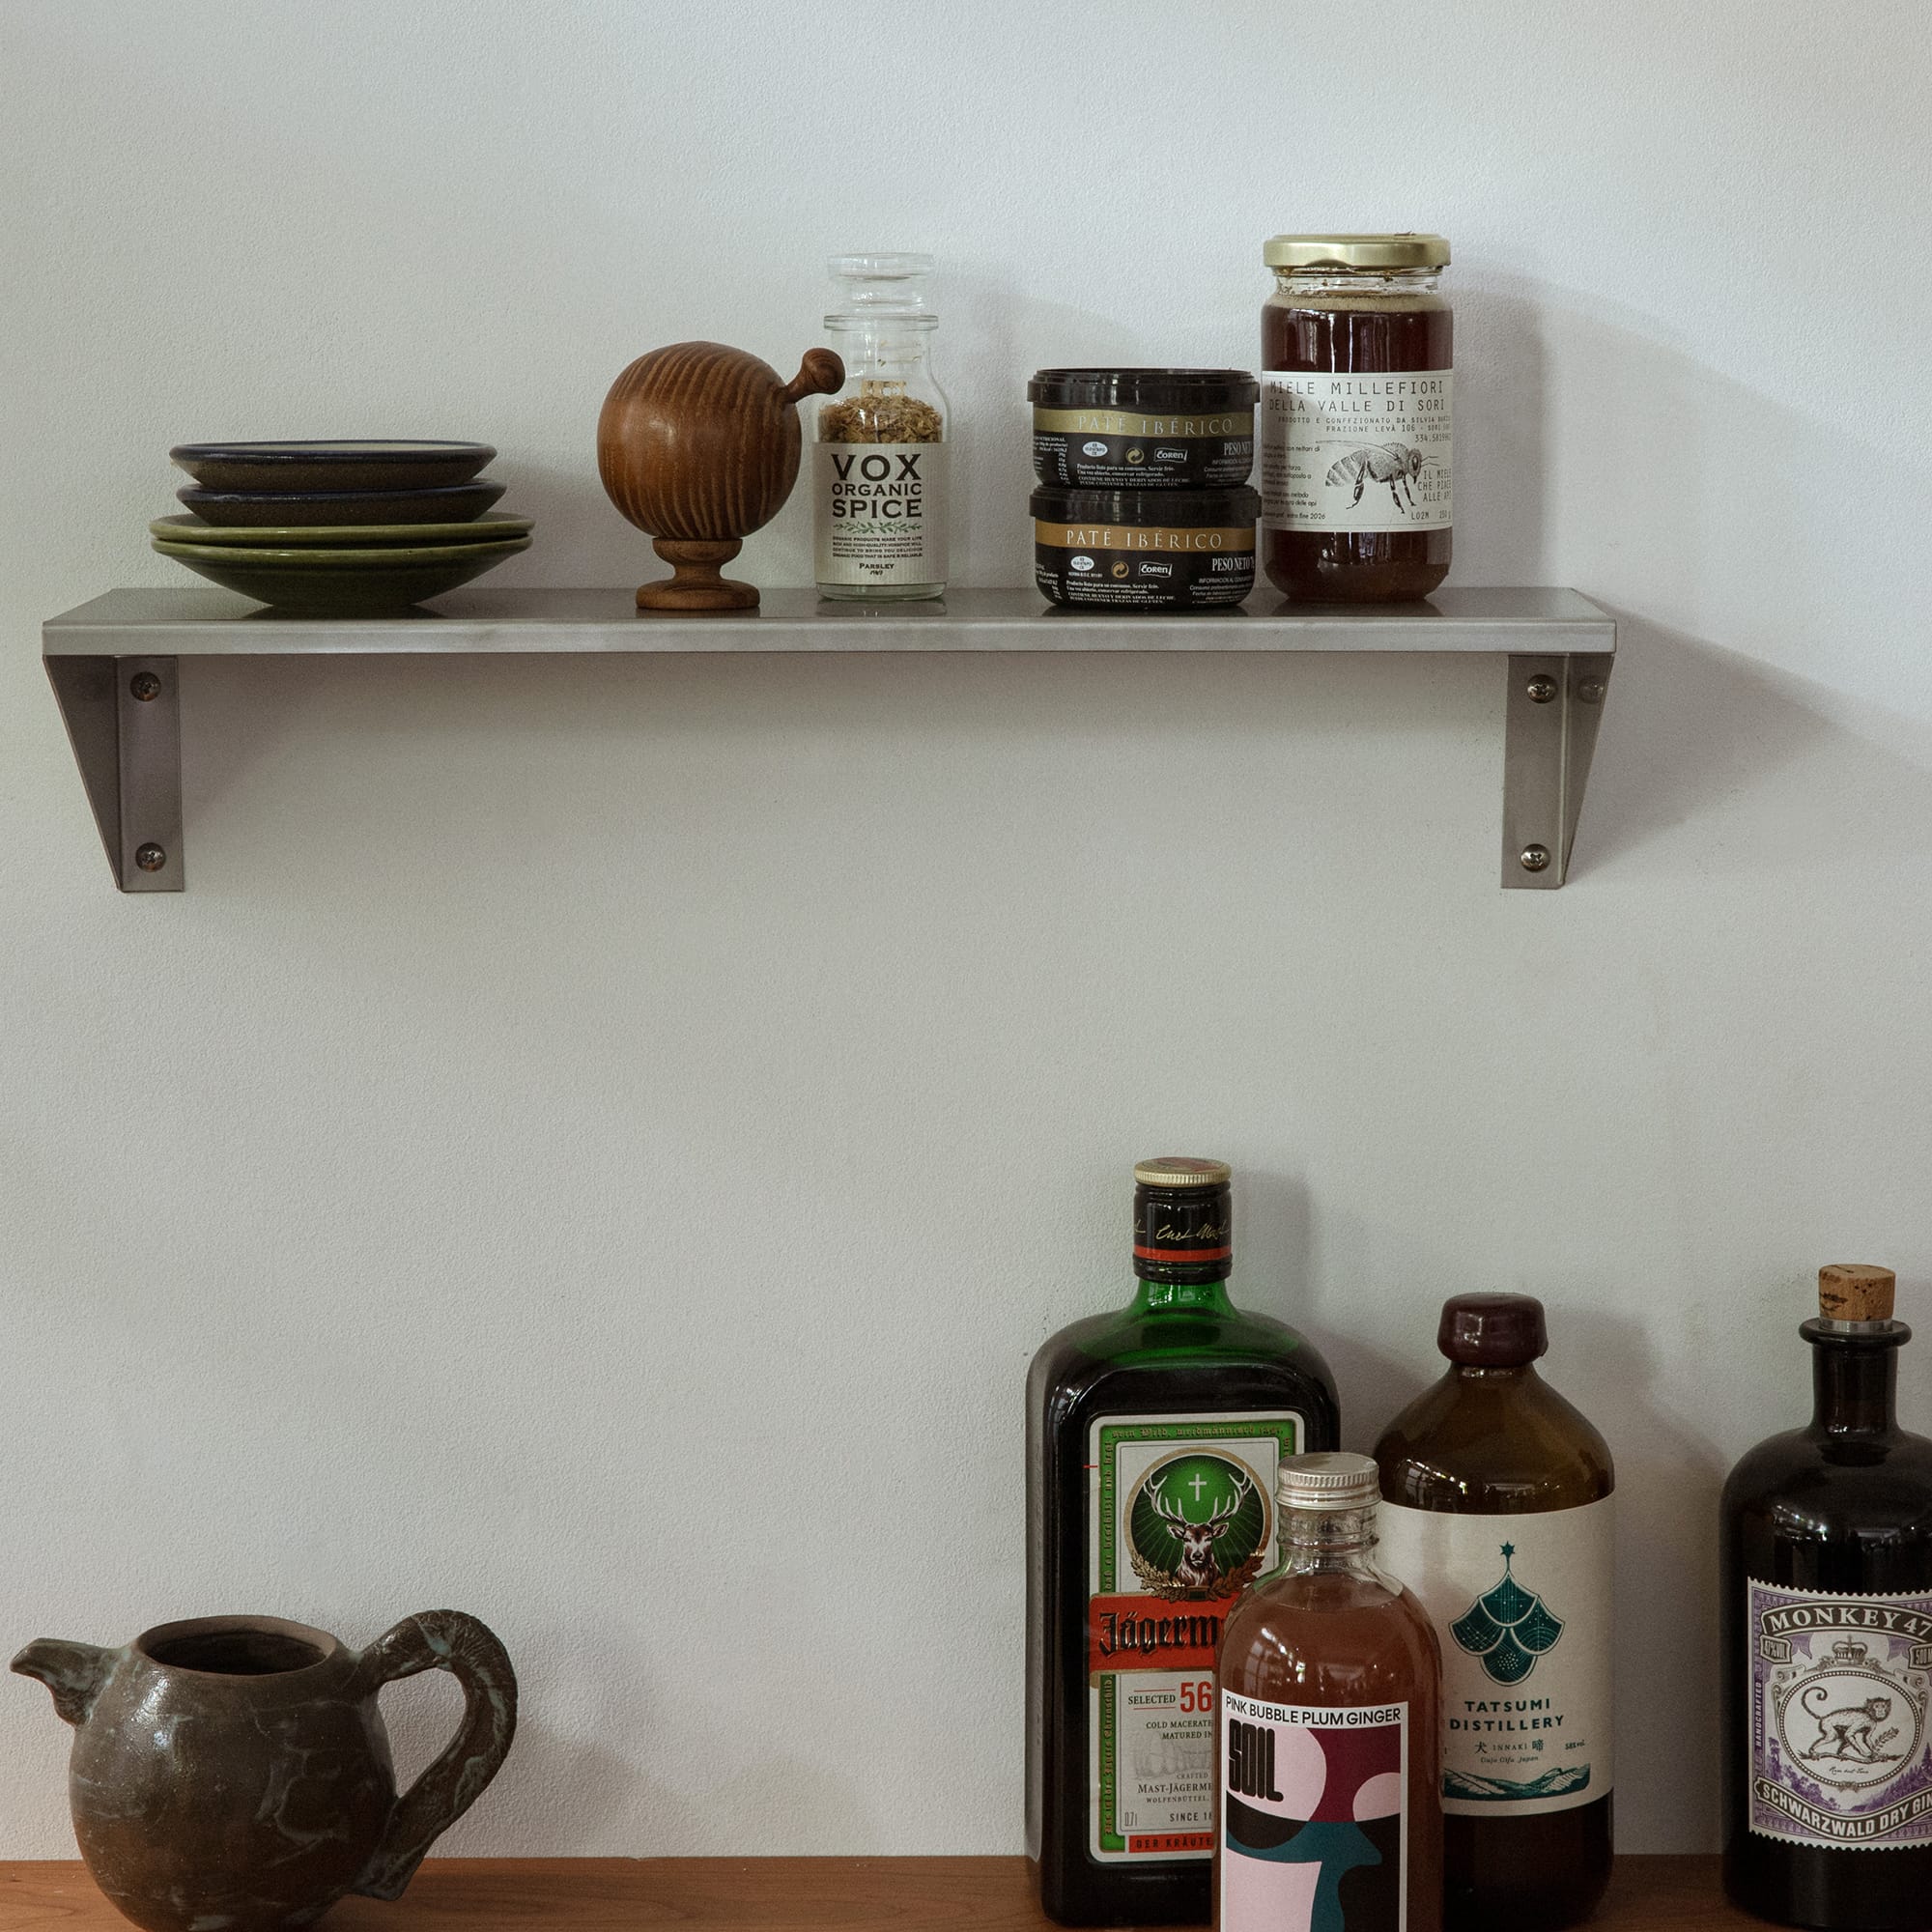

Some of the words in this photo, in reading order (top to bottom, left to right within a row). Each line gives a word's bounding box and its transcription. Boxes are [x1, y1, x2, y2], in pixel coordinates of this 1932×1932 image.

[1270, 381, 1315, 395] MIELE
[1330, 380, 1443, 395] MILLEFIORI
[1269, 399, 1305, 412] DELLA
[1318, 400, 1372, 412] VALLE
[1386, 400, 1404, 412] DI
[1417, 398, 1444, 412] SORI
[1078, 414, 1125, 433] PATÉ
[1142, 417, 1234, 435] IBÉRICO
[1375, 424, 1396, 433] LEVÀ
[1402, 423, 1415, 433] 106
[1223, 441, 1241, 456] PESO
[831, 453, 922, 481] VOX
[1424, 469, 1433, 480] IL
[831, 483, 923, 497] ORGANIC
[1417, 481, 1433, 491] CHE
[1422, 492, 1440, 502] ALLE
[832, 497, 923, 519] SPICE
[1066, 528, 1111, 546] PATÉ
[1126, 530, 1222, 549] IBÉRICO
[1211, 557, 1234, 572] PESO
[1234, 556, 1249, 571] NETO
[1768, 1607, 1901, 1633] MONKEY
[1903, 1617, 1932, 1636] 47
[1099, 1611, 1224, 1658] Jägerm
[1127, 1694, 1177, 1705] SELECTED
[1179, 1681, 1212, 1713] 56
[1226, 1695, 1248, 1715] PINK
[1250, 1704, 1298, 1723] BUBBLE
[1302, 1711, 1344, 1725] PLUM
[1347, 1708, 1401, 1724] GINGER
[1464, 1698, 1550, 1713] TATSUMI
[1170, 1719, 1213, 1728] MACERATE
[1450, 1715, 1564, 1731] DISTILLERY
[1474, 1741, 1488, 1754] 犬
[1492, 1743, 1527, 1751] INNAKI
[1229, 1718, 1284, 1803] SOIL
[1518, 1755, 1539, 1764] Japan
[1138, 1782, 1213, 1794] MAST-JÄGERME
[1169, 1812, 1199, 1822] SINCE
[1763, 1785, 1875, 1836] SCHWARZWALD
[1880, 1803, 1910, 1830] DRY
[1913, 1790, 1932, 1814] GIN
[1136, 1838, 1159, 1849] DER
[1166, 1835, 1211, 1848] KRÄUTE
